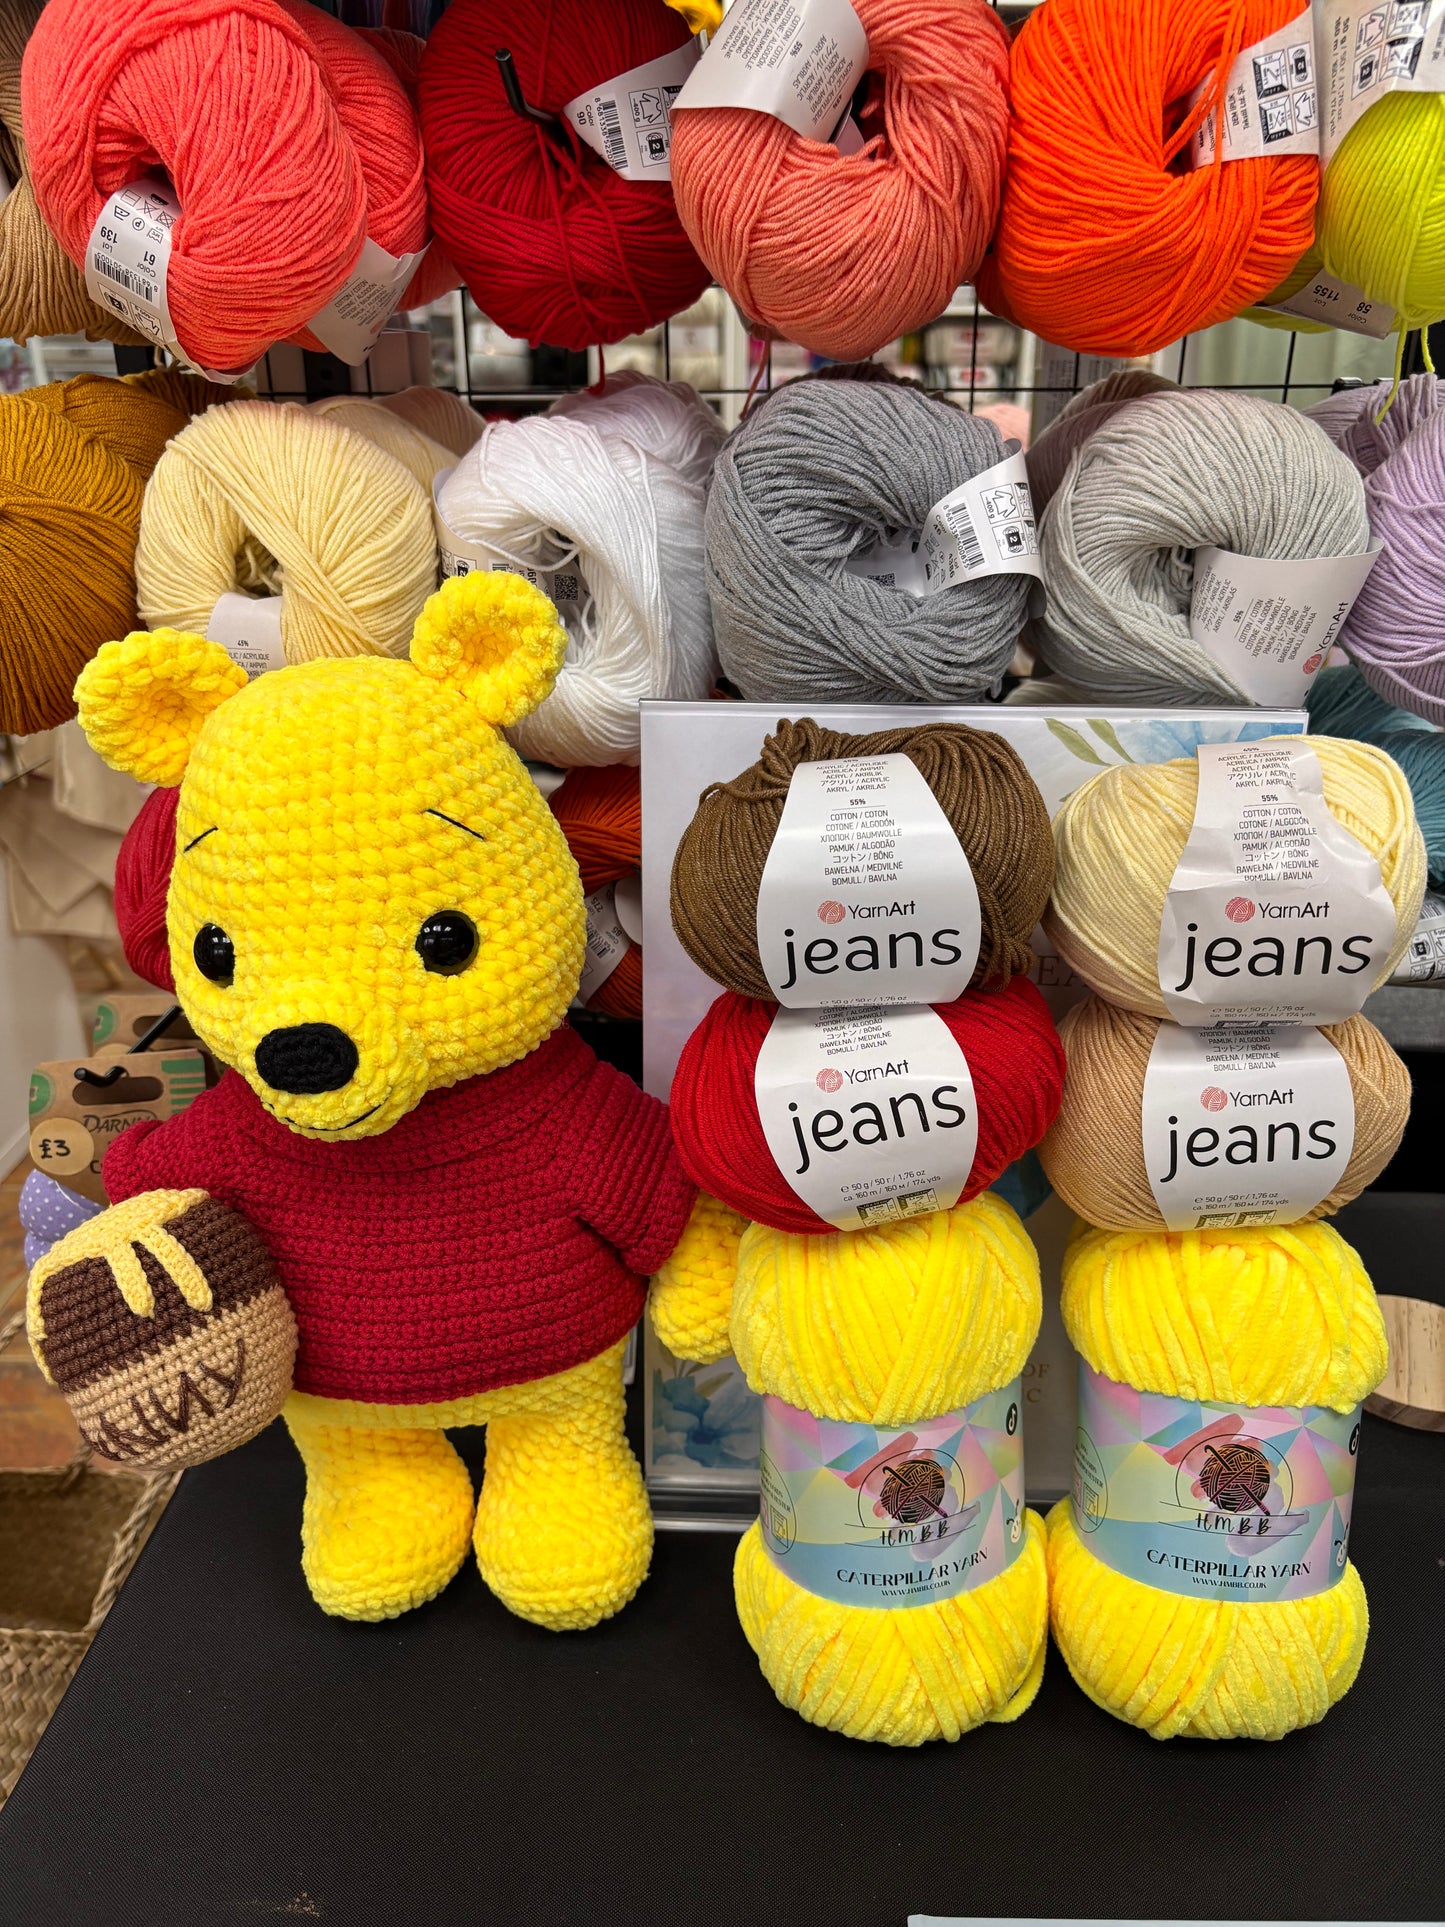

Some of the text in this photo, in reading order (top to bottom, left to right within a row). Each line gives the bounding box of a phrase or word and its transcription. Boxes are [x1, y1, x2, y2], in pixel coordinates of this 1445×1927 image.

[768, 15, 800, 68] COTTON COTON
[791, 41, 802, 57] 55%
[576, 111, 587, 126] 90
[100, 225, 118, 244] 139
[143, 250, 156, 266] 61
[136, 262, 156, 278] Color
[1313, 284, 1340, 302] 1155
[1356, 301, 1373, 314] 58
[1233, 609, 1243, 623] 55%
[1238, 598, 1263, 643] COTTON COTON
[1315, 601, 1349, 653] YarnArt
[237, 639, 249, 647] 45%
[1244, 628, 1259, 650] COTONE
[1288, 610, 1316, 661] BOMULL BAVLNA
[1262, 634, 1275, 654] PAMUK
[856, 783, 887, 791] AKRILAS
[1235, 780, 1259, 788] AKRYL
[849, 798, 866, 806] 55%
[1261, 794, 1278, 802] 55%
[830, 810, 889, 821] COTTON COTON
[1242, 807, 1302, 818] COTTON COTON
[825, 822, 854, 832] COTONE
[1238, 819, 1268, 829] COTONE
[856, 828, 903, 840] BAUMWOLLE
[1270, 827, 1318, 839] BAUMWOLLE
[829, 843, 855, 853] PAMUK
[1242, 842, 1268, 851] PAMUK
[831, 872, 897, 886] BOMULL BAVLNA
[1283, 871, 1313, 881] BAVLNA
[847, 900, 916, 920] YarnArt
[1258, 901, 1330, 919] YarnArt
[780, 928, 962, 990] jeans
[1174, 922, 1373, 992] jeans
[822, 1025, 846, 1033] PAMUK
[826, 1040, 888, 1056] BOMULL BAVLNA
[844, 1059, 909, 1085] YarnArt
[1213, 1061, 1276, 1072] BOMULL BAVLNA
[1229, 1088, 1294, 1108] YarnArt
[788, 1085, 966, 1175] jeans
[38, 1139, 71, 1160] £3
[1159, 1115, 1337, 1183] jeans
[851, 1182, 862, 1191] 50
[874, 1177, 886, 1186] 50
[916, 1169, 926, 1177] oz
[855, 1190, 869, 1199] 160
[884, 1184, 898, 1193] 160
[912, 1178, 926, 1186] 174
[926, 1175, 941, 1184] yds
[837, 1547, 988, 1586] CATERPILLAR YARN
[1146, 1549, 1312, 1578] CATERPILLAR YARN
